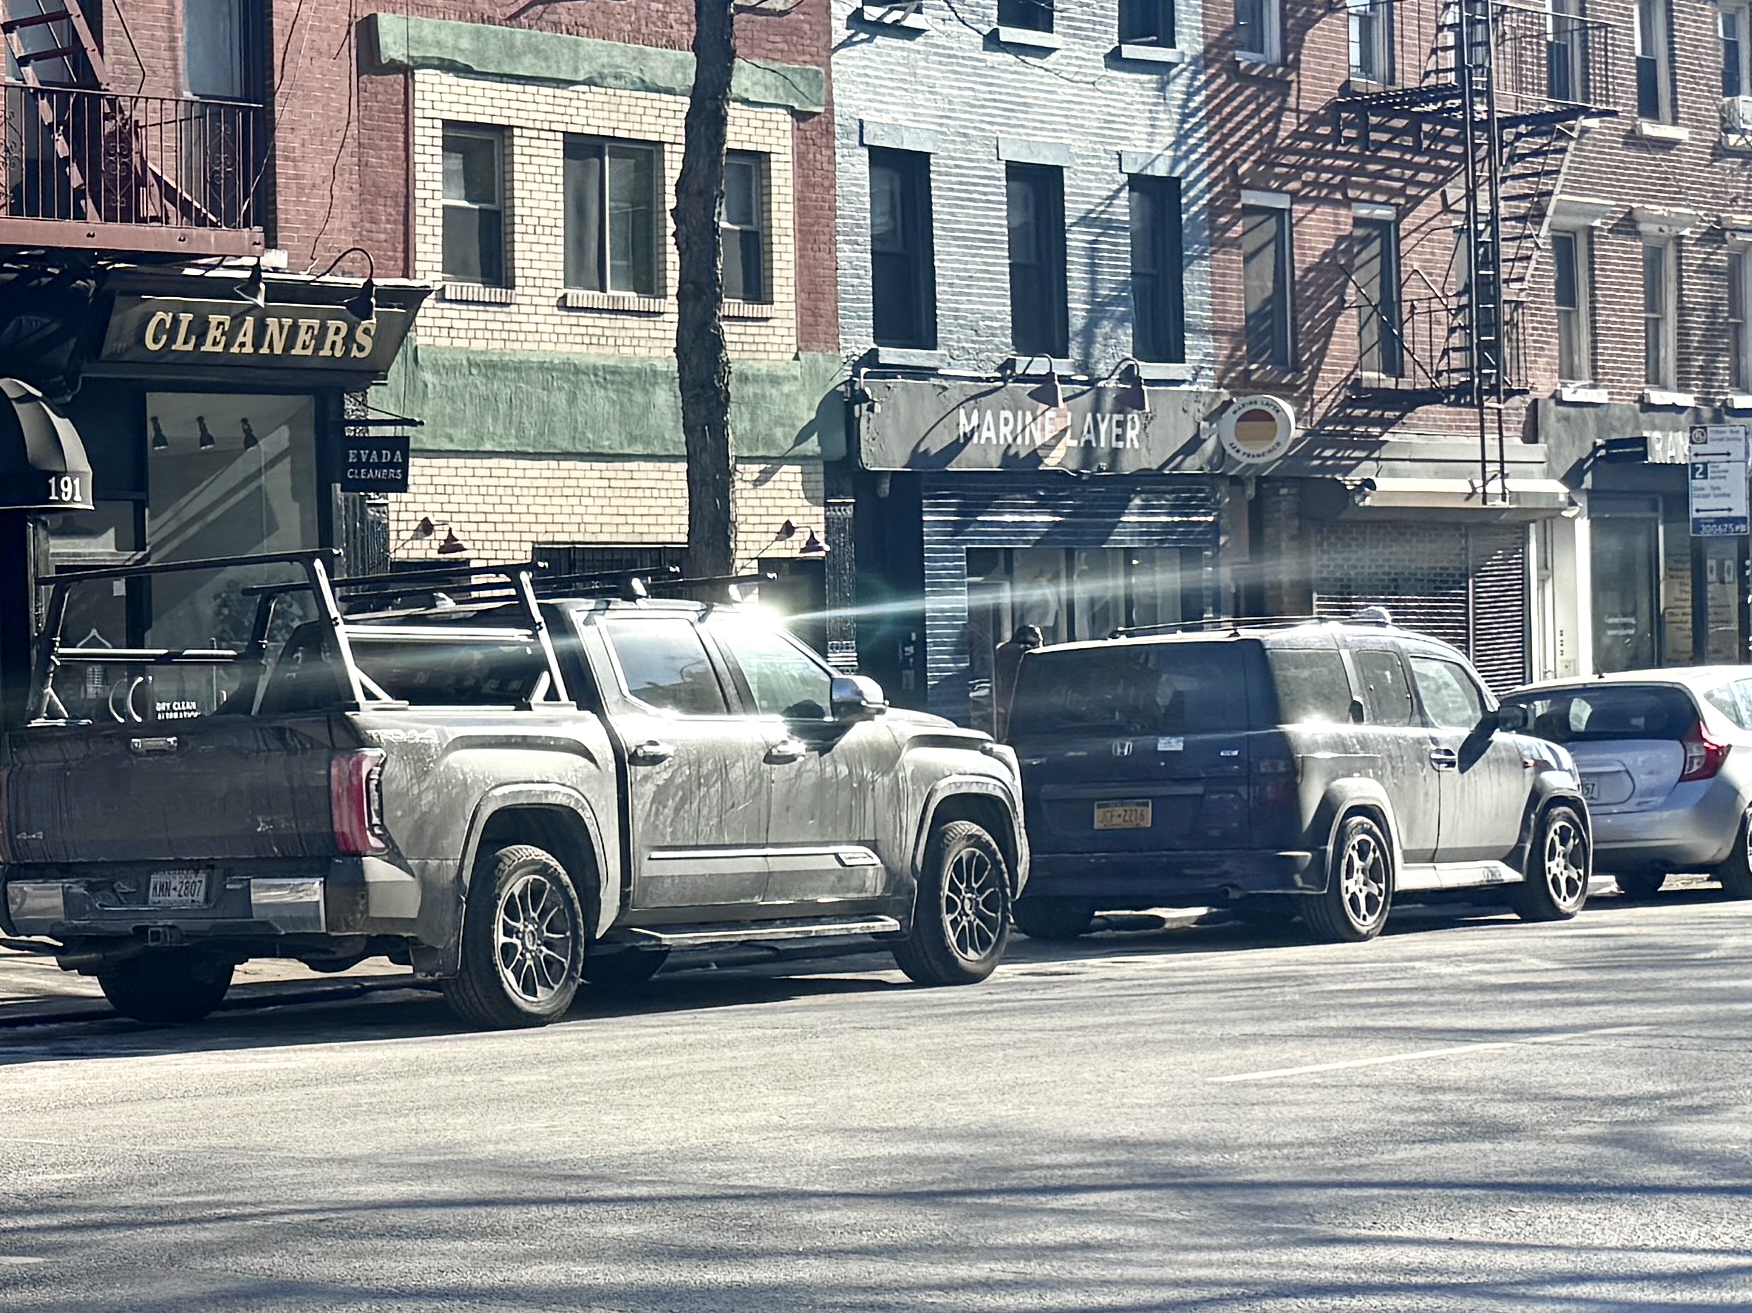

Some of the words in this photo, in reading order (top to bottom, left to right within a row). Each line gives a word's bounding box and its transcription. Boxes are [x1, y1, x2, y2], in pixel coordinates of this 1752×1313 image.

[143, 309, 378, 359] CLEANERS
[959, 407, 1060, 446] MARINE
[1066, 411, 1141, 451] LAYER
[348, 449, 403, 464] EVADA
[347, 468, 403, 481] CLEANERS
[47, 476, 83, 503] 191
[172, 700, 197, 712] CLEAN
